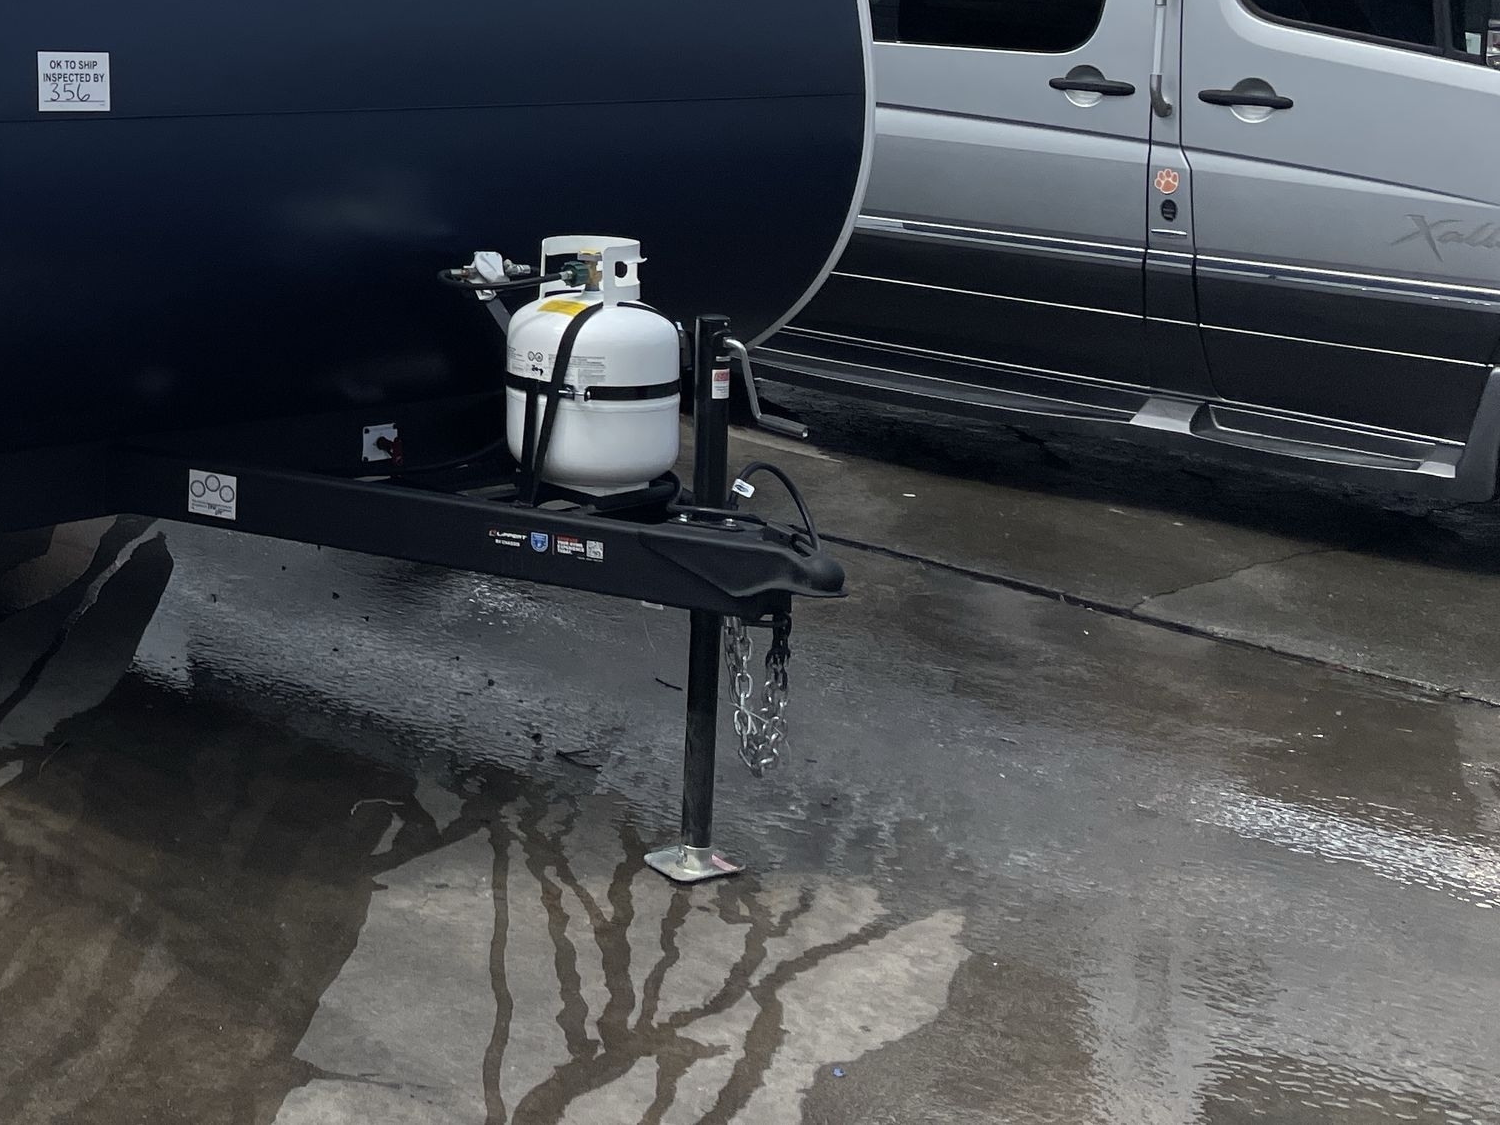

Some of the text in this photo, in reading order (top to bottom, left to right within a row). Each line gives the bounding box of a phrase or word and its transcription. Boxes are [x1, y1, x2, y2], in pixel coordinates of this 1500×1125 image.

[49, 59, 98, 70] OK TO SHIP
[43, 73, 106, 83] INSPECTED BY
[50, 82, 91, 103] 356
